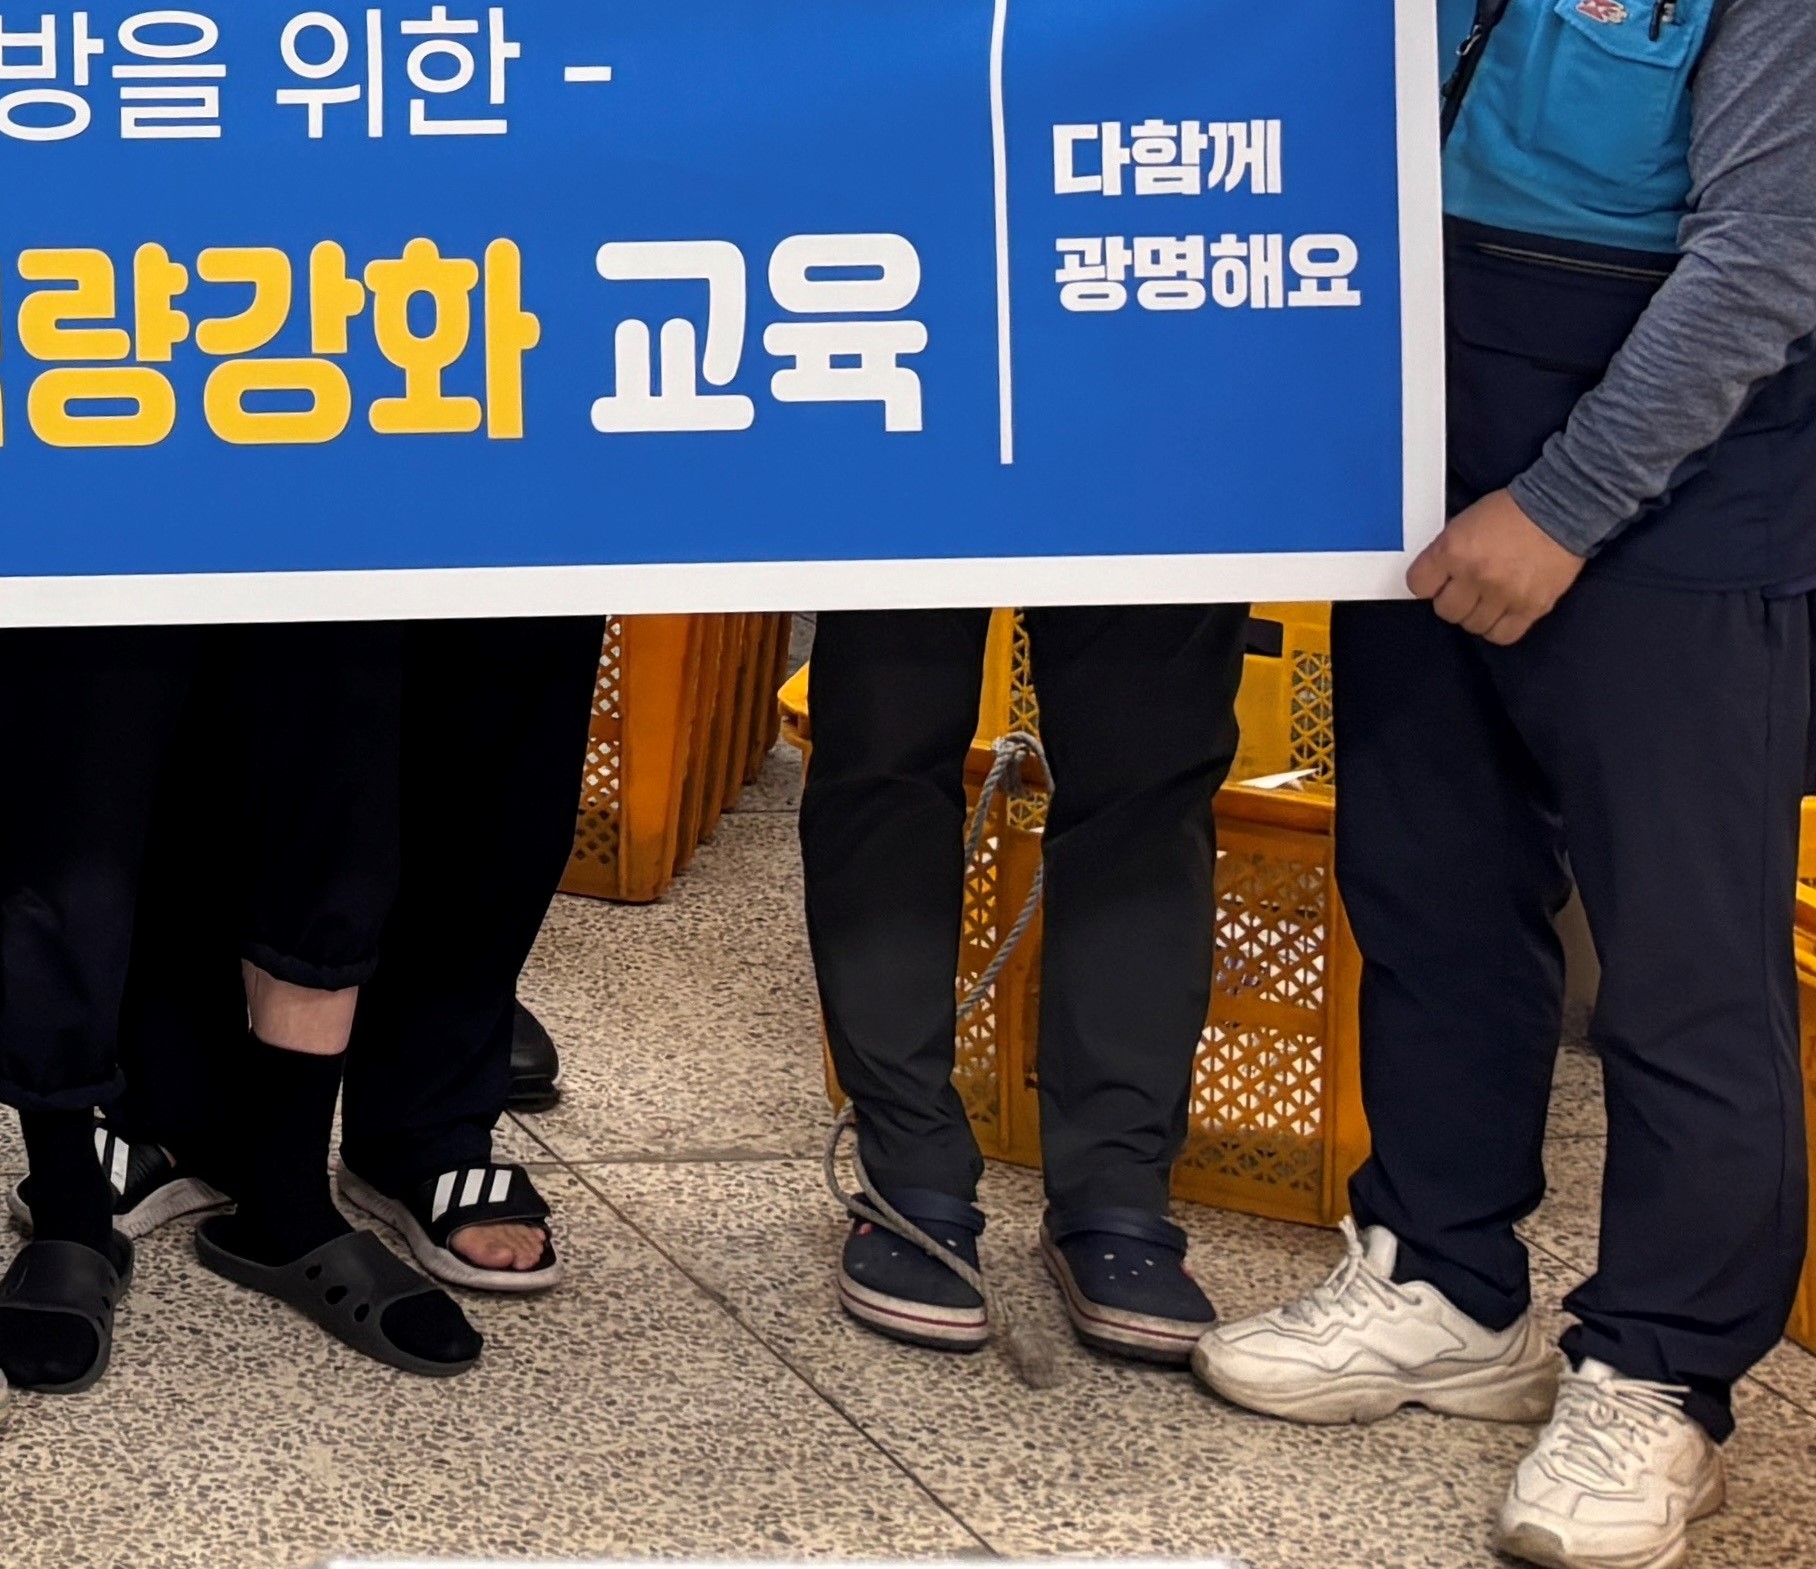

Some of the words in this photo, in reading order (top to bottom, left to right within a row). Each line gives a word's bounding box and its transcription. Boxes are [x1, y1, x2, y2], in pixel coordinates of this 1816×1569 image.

[276, 5, 521, 139] 위한
[1052, 119, 1282, 196] 다함께
[1055, 233, 1361, 312] 광명해요
[590, 233, 928, 433] 교육
